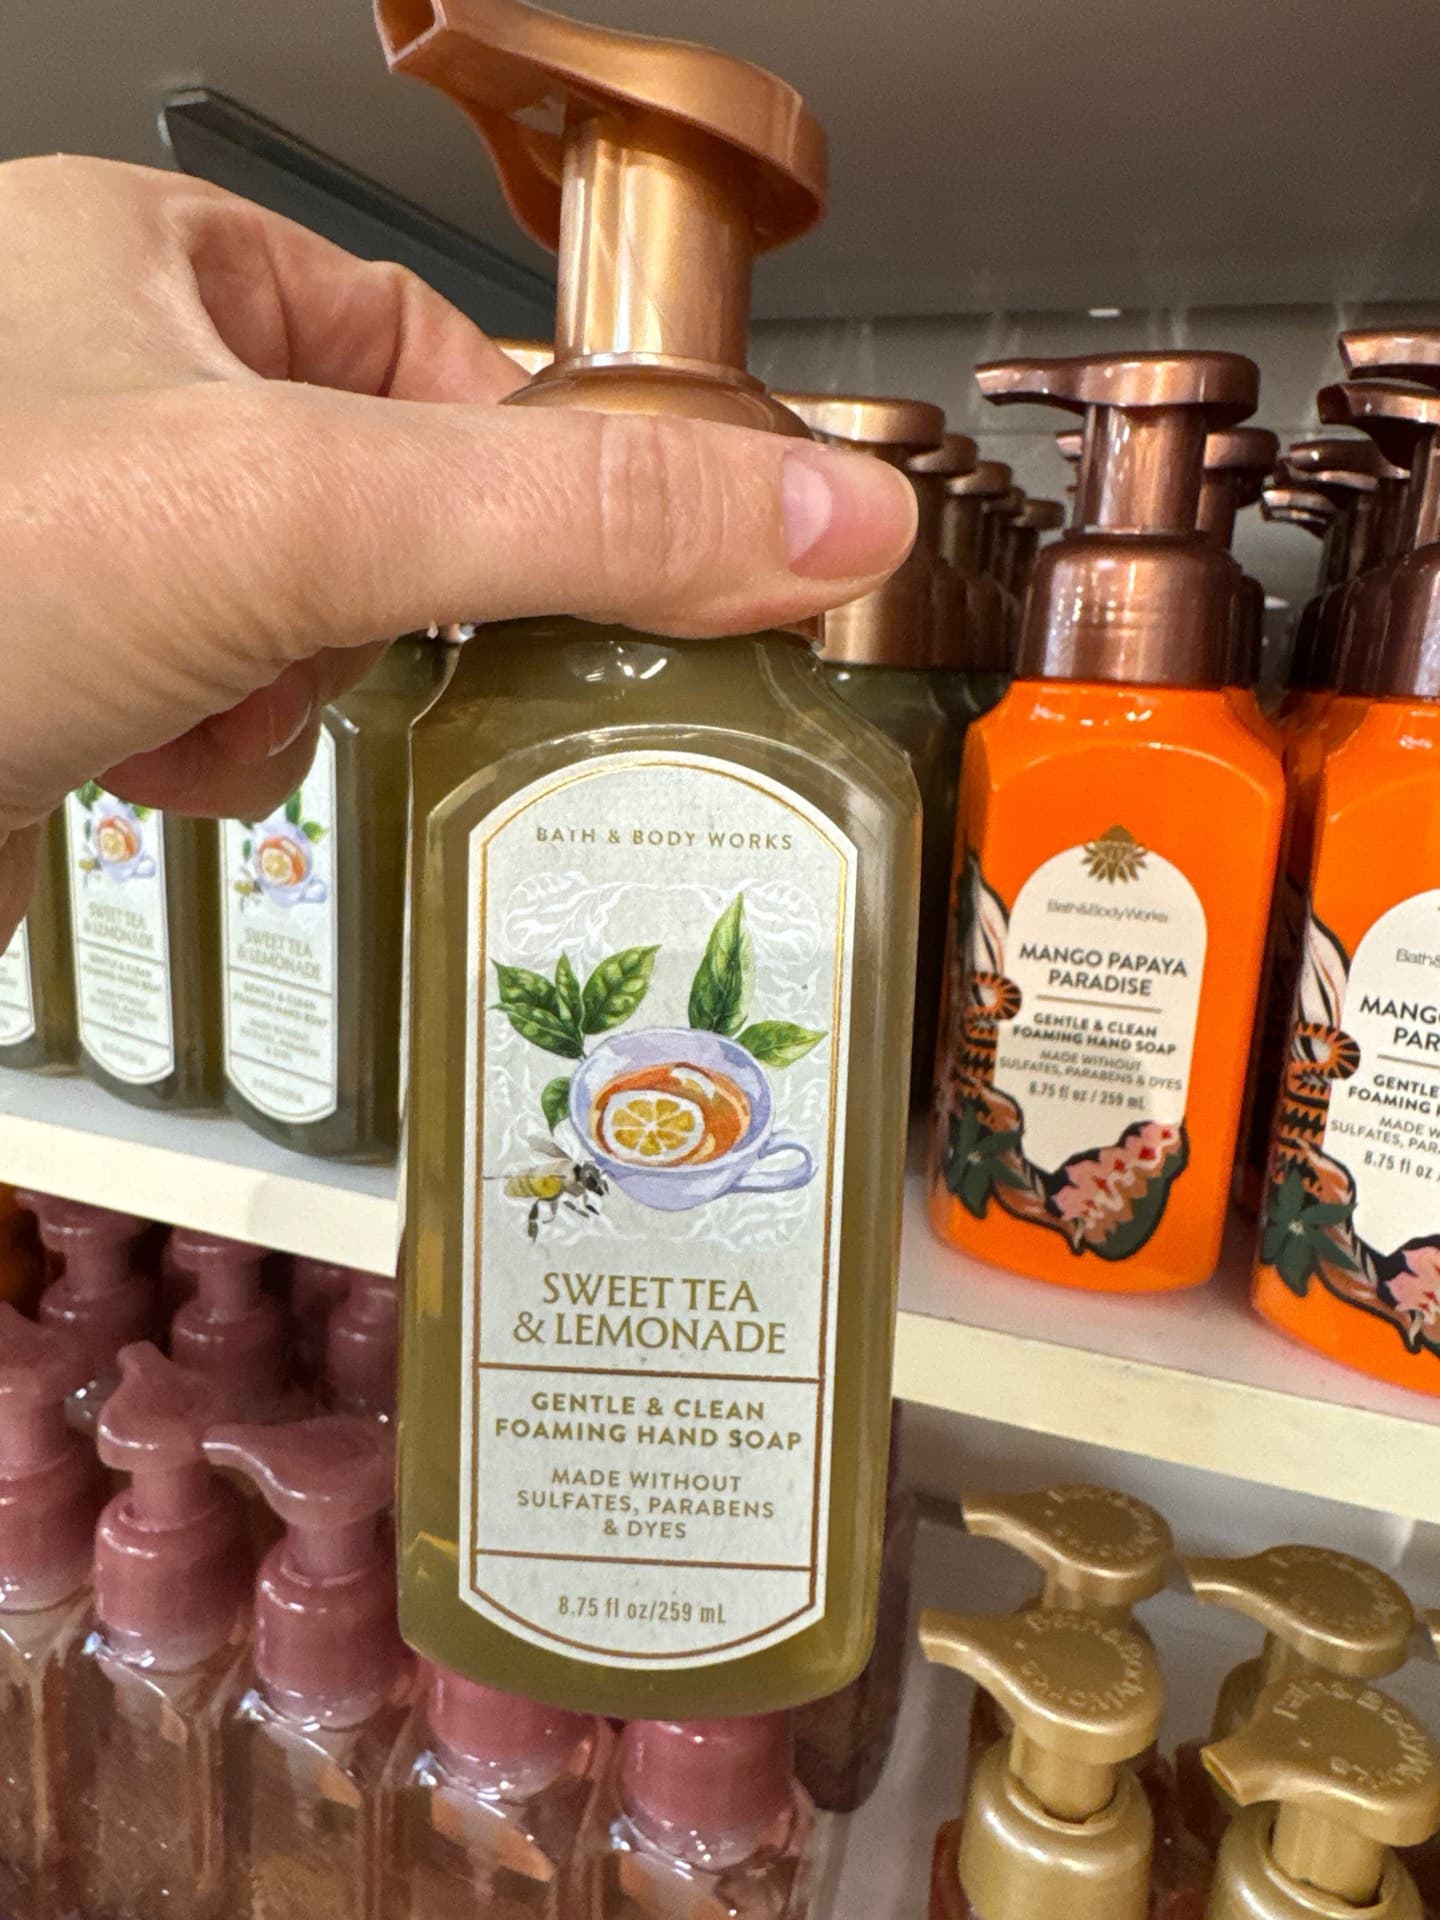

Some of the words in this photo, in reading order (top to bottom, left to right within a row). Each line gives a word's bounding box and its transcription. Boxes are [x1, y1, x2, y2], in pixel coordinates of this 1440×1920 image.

[537, 827, 596, 844] BATH
[609, 829, 621, 844] &
[633, 830, 696, 847] BODY
[709, 832, 792, 850] WORKS
[1019, 943, 1102, 967] MANGO
[1108, 952, 1187, 977] PAPAYA
[1048, 969, 1153, 996] PARADISE
[1360, 994, 1440, 1025] MANG
[1033, 1013, 1089, 1030] GENTLE
[1094, 1020, 1103, 1031] &
[1107, 1021, 1157, 1037] CLEAN
[1012, 1025, 1083, 1044] FOAMING
[1087, 1034, 1131, 1049] HAND
[1136, 1040, 1176, 1055] SOAP
[1000, 1056, 1061, 1076] SULFATES,
[1065, 1065, 1133, 1084] PARABENS
[1136, 1075, 1145, 1086] &
[1149, 1076, 1182, 1090] DYES
[1040, 1050, 1078, 1062] MADE
[1081, 1054, 1142, 1070] WITHOUT
[1030, 1081, 1055, 1096] 8.75
[1100, 1089, 1123, 1105] 259
[1348, 1086, 1431, 1114] FOAMING
[1373, 1074, 1440, 1098] GENTLE
[1330, 1119, 1404, 1148] SULFATES,
[1408, 1137, 1440, 1154] PAR
[1379, 1116, 1425, 1136] MADE
[1364, 1150, 1394, 1171] 8.75
[1416, 1165, 1433, 1179] oz
[543, 1272, 674, 1310] SWEET
[683, 1278, 759, 1312] TEA
[513, 1311, 545, 1343] &
[555, 1313, 786, 1354] LEMONADE
[531, 1392, 636, 1415] GENTLE
[647, 1397, 664, 1416] &
[675, 1398, 765, 1420] CLEAN
[495, 1418, 627, 1442] FOAMING
[637, 1429, 718, 1448] HAND
[728, 1430, 802, 1451] SOAP
[551, 1468, 621, 1488] MADE
[630, 1471, 741, 1493] WITHOUT
[517, 1490, 640, 1515] SULFATES,
[648, 1498, 774, 1518] PARABENS
[603, 1519, 617, 1536] &
[627, 1520, 686, 1539] DYES
[558, 1596, 598, 1617] 8.75
[605, 1597, 619, 1618] fl
[627, 1597, 692, 1622] oz/259
[701, 1603, 726, 1624] mL
